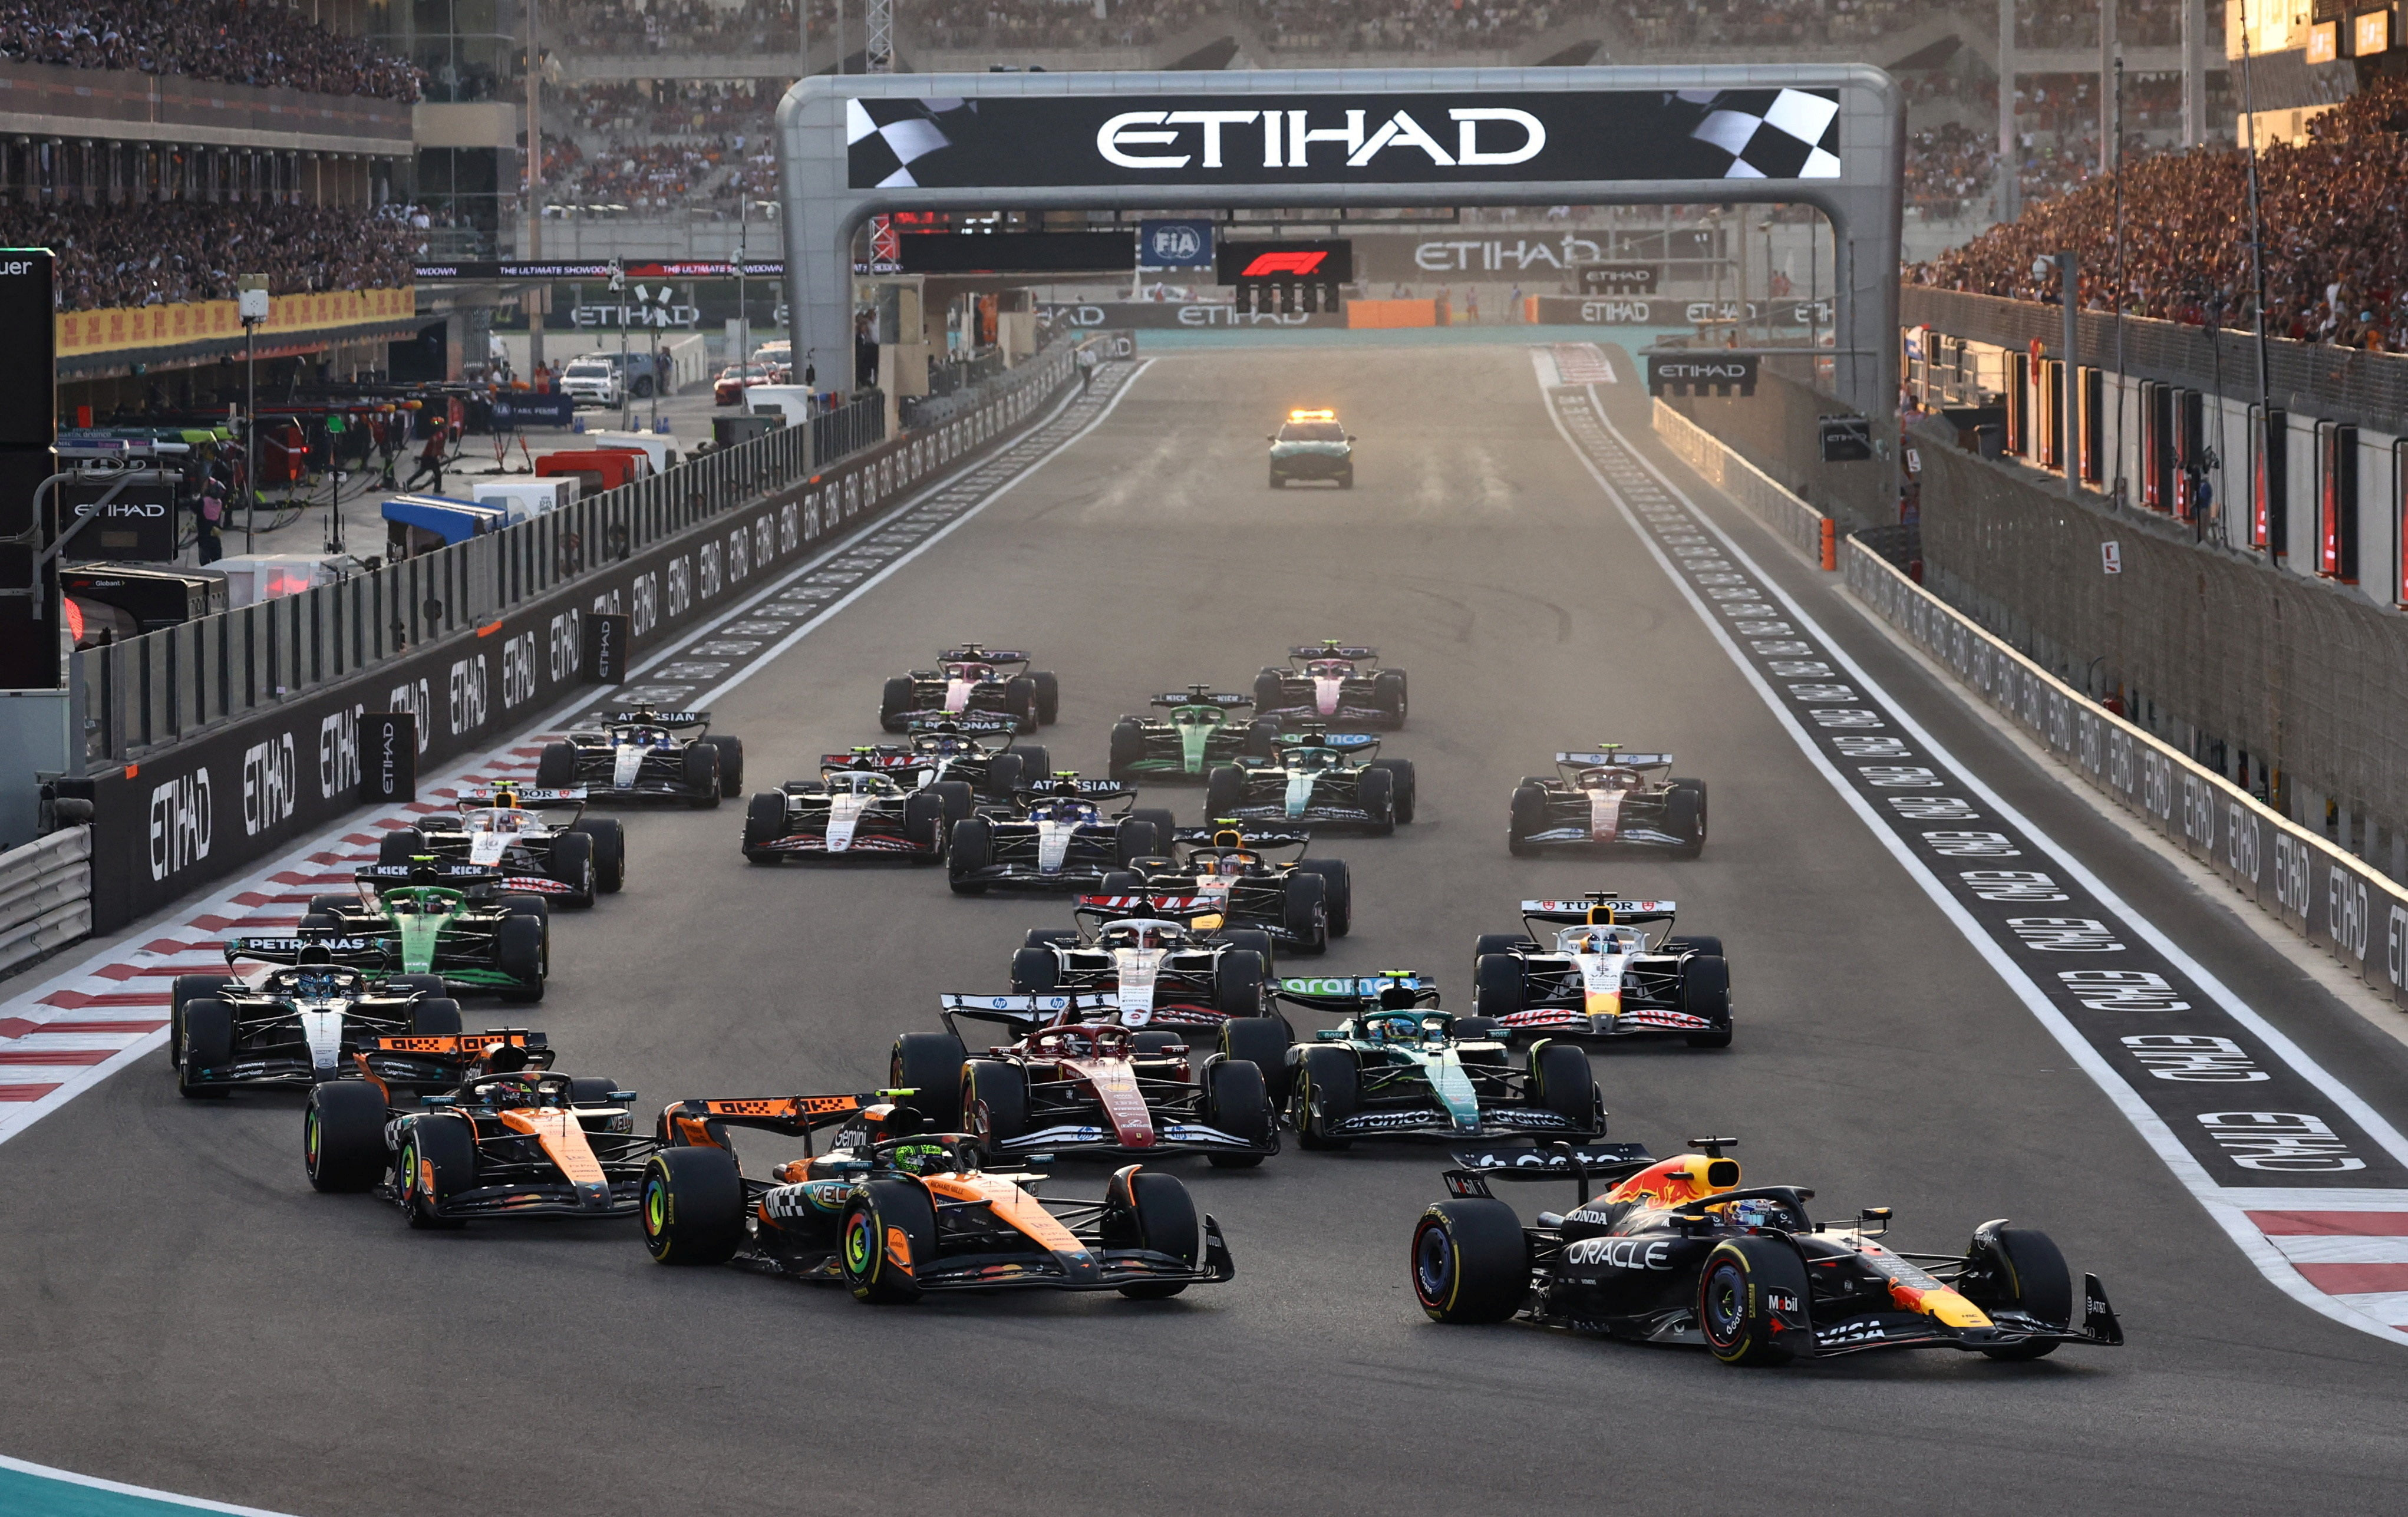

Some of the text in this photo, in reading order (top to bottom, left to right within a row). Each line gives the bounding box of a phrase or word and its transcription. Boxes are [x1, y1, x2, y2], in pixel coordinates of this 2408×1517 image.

[1096, 109, 1546, 169] ETIHAD
[500, 265, 620, 275] THE ULTIMATE SHOWDO
[1586, 270, 1650, 282] ETIHAD
[1581, 301, 1650, 323] ETIHAD
[1658, 364, 1746, 378] ETIHAD
[551, 608, 579, 682] ETIHAD
[600, 621, 611, 678] ETIHAD
[503, 631, 536, 708] ETIHAD
[450, 654, 487, 736] ETIHAD
[383, 722, 394, 794] ETIHAD
[243, 731, 295, 836] ETIHAD
[2185, 773, 2215, 850] ETIHAD
[150, 766, 212, 882] ETIHAD
[2229, 802, 2260, 884] ETIHAD
[377, 865, 482, 876] KICK KICK
[2276, 832, 2310, 919] ETIHAD
[1562, 902, 1634, 910] TUOR
[2330, 865, 2368, 961] ETIHAD
[249, 938, 365, 950] PETRNAS
[2006, 918, 2126, 952] ETIHAD
[992, 997, 1064, 1008] hp hp
[2057, 970, 2192, 1012] ETIHAD
[1503, 1010, 1571, 1027] HUGO
[1637, 1010, 1704, 1028] HUGO
[391, 1040, 440, 1050] OKX
[2120, 1035, 2271, 1083] ETIHAD
[720, 1102, 770, 1114] OKX
[1345, 1110, 1430, 1128] aramco
[834, 1125, 867, 1147] Gemini
[2196, 1112, 2367, 1172] ETIHAD
[931, 1181, 950, 1191] RICHARD
[1447, 1176, 1474, 1195] Mobil
[1566, 1210, 1608, 1226] HONDA
[1568, 1240, 1674, 1271] ORACLE
[1769, 1294, 1797, 1312] Mobil
[2093, 1300, 2106, 1314] AT&T
[1730, 1305, 1743, 1330] Gate
[1815, 1320, 1886, 1345] VISA
